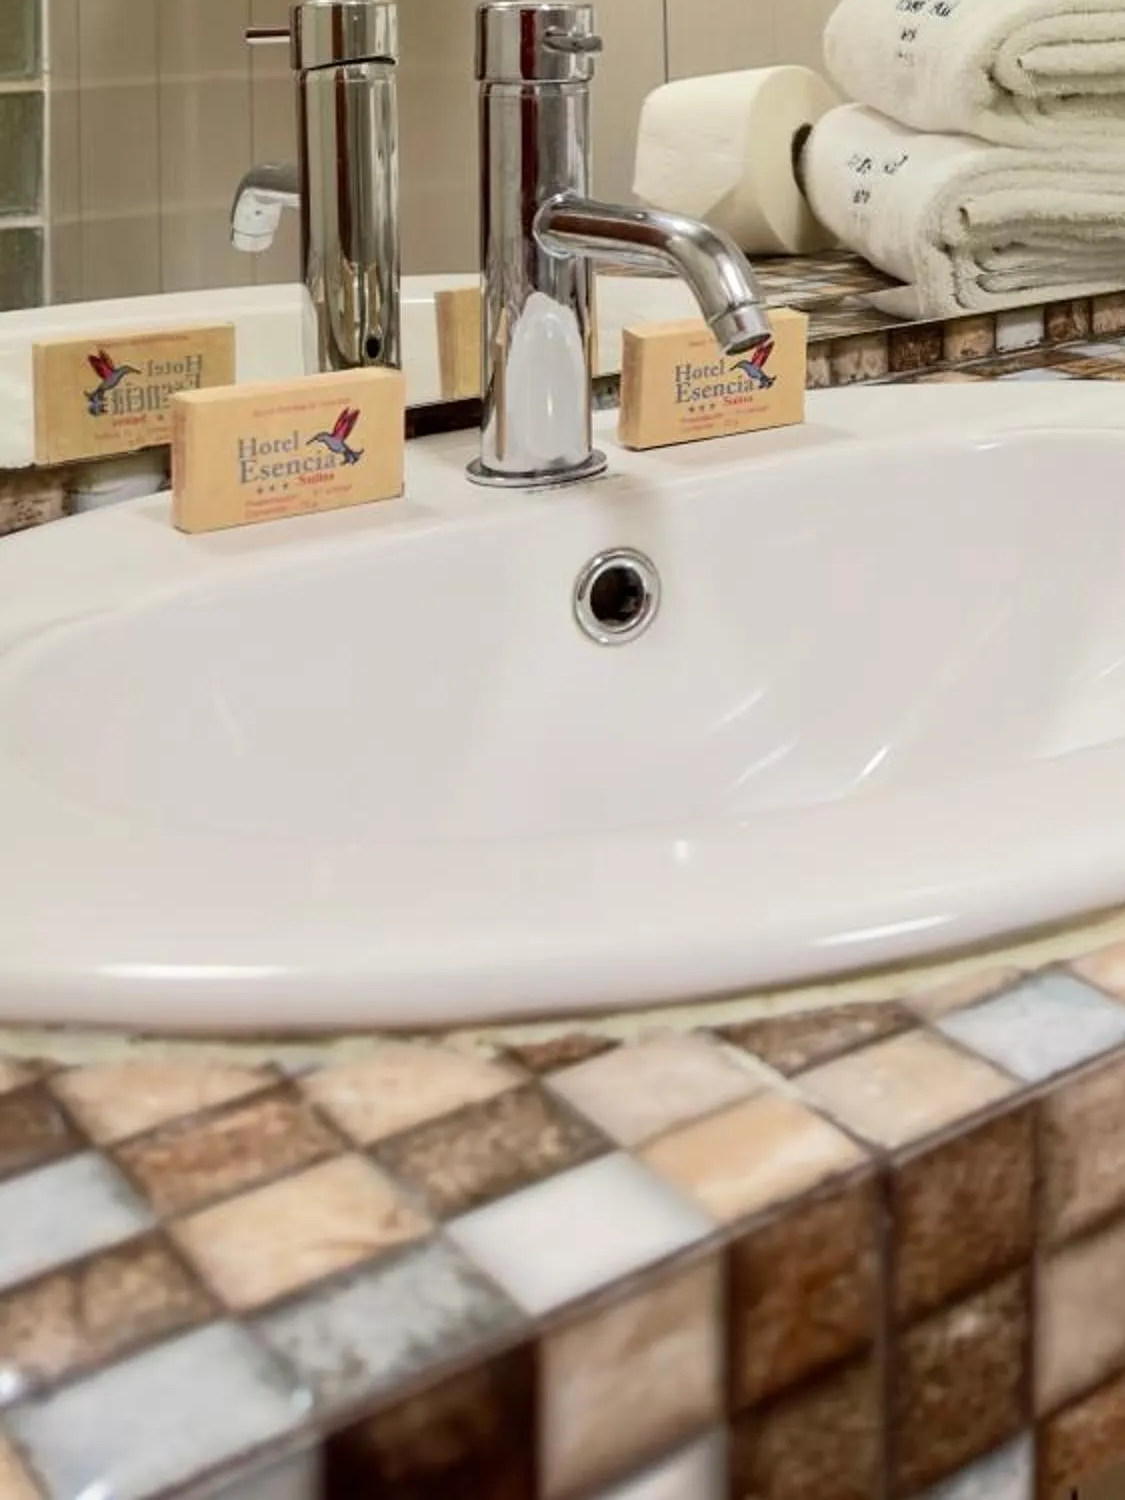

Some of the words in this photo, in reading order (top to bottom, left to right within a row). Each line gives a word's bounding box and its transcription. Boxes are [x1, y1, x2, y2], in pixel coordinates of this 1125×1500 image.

[674, 359, 725, 383] Hotel
[675, 375, 753, 404] Esencia
[238, 430, 299, 458] Hotel
[240, 451, 336, 484] Esencia
